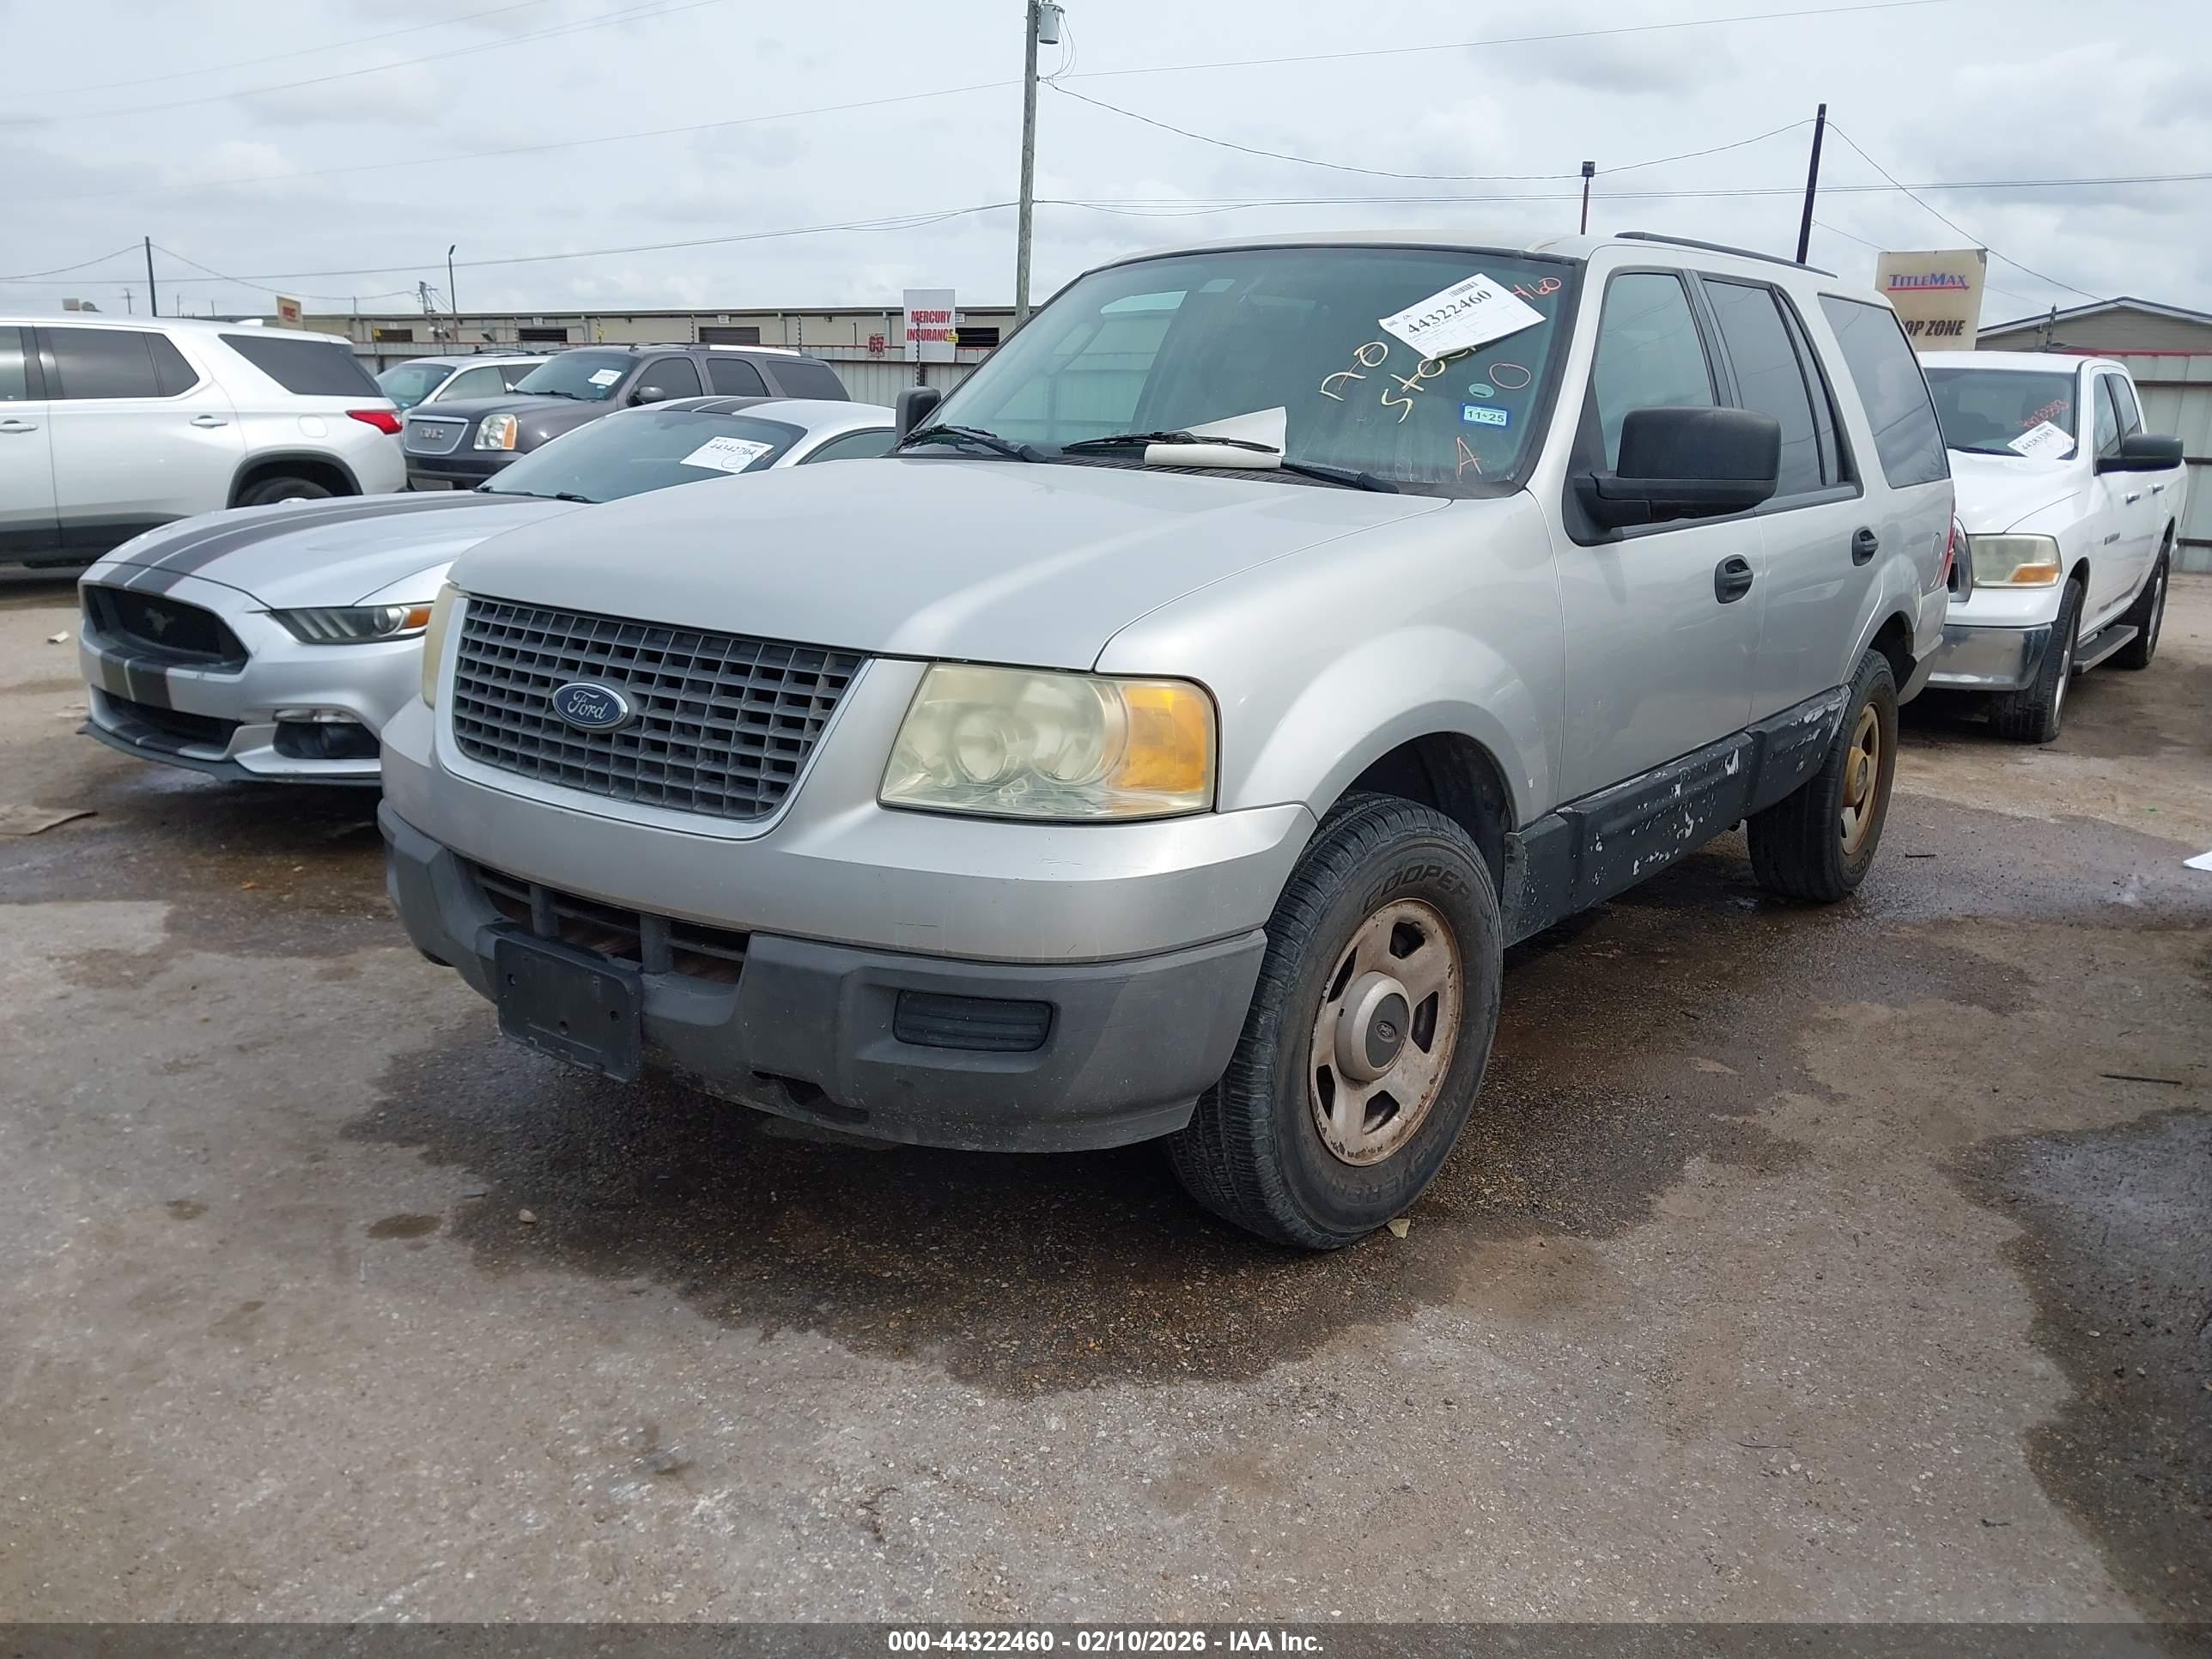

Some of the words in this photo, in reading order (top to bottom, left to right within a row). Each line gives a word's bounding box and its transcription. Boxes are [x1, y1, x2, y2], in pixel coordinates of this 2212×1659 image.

[911, 310, 951, 323] MERCURY
[1408, 289, 1492, 334] 44322460
[1924, 320, 1966, 336] ZONE
[1456, 437, 1484, 478] A
[567, 690, 609, 720] Ford
